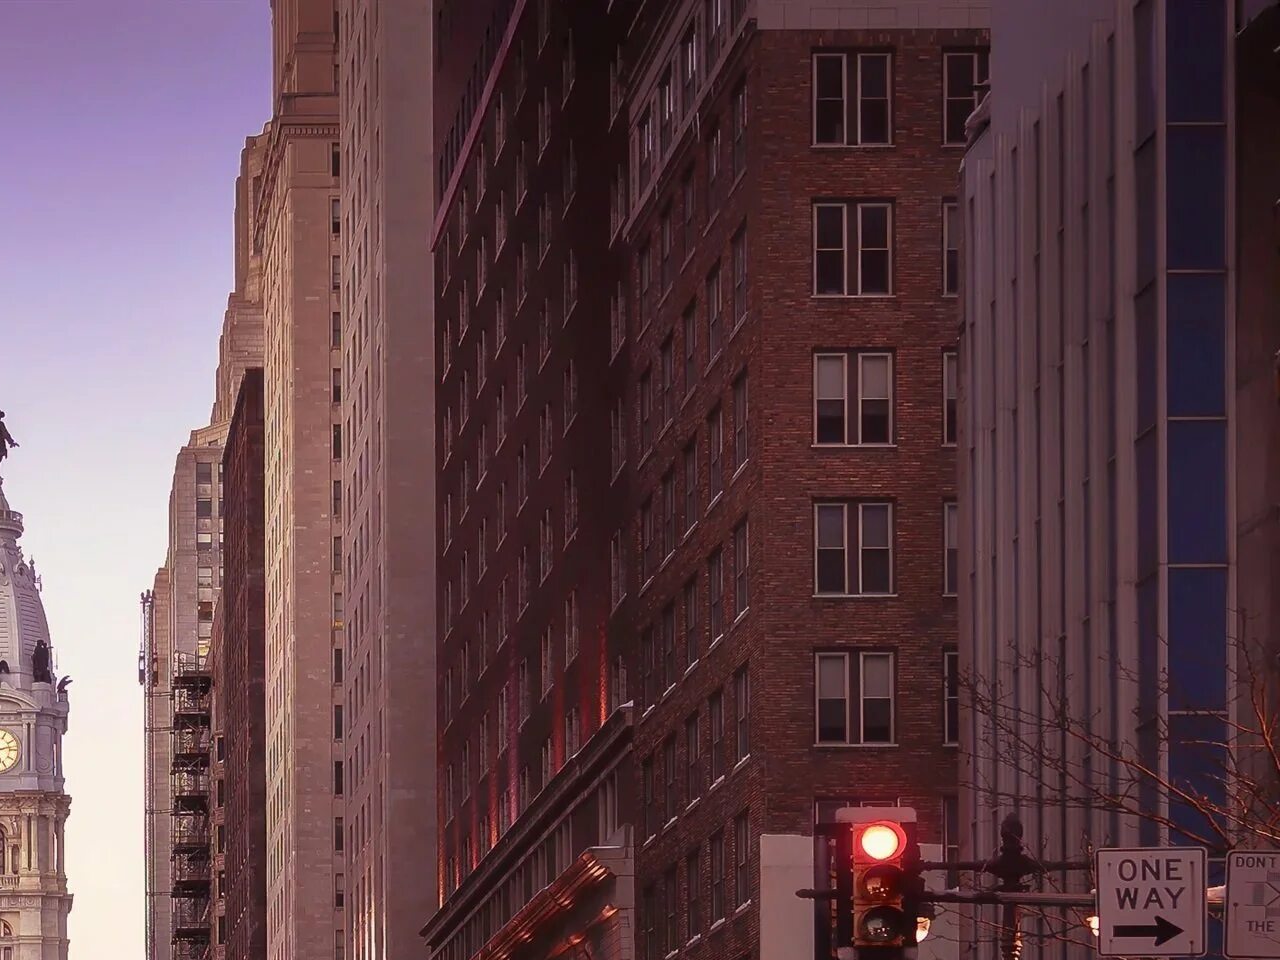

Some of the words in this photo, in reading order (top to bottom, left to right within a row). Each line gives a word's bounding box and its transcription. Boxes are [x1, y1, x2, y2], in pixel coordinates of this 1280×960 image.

[1118, 859, 1183, 882] ONE
[1116, 887, 1185, 909] WAY
[1247, 920, 1275, 932] THE
